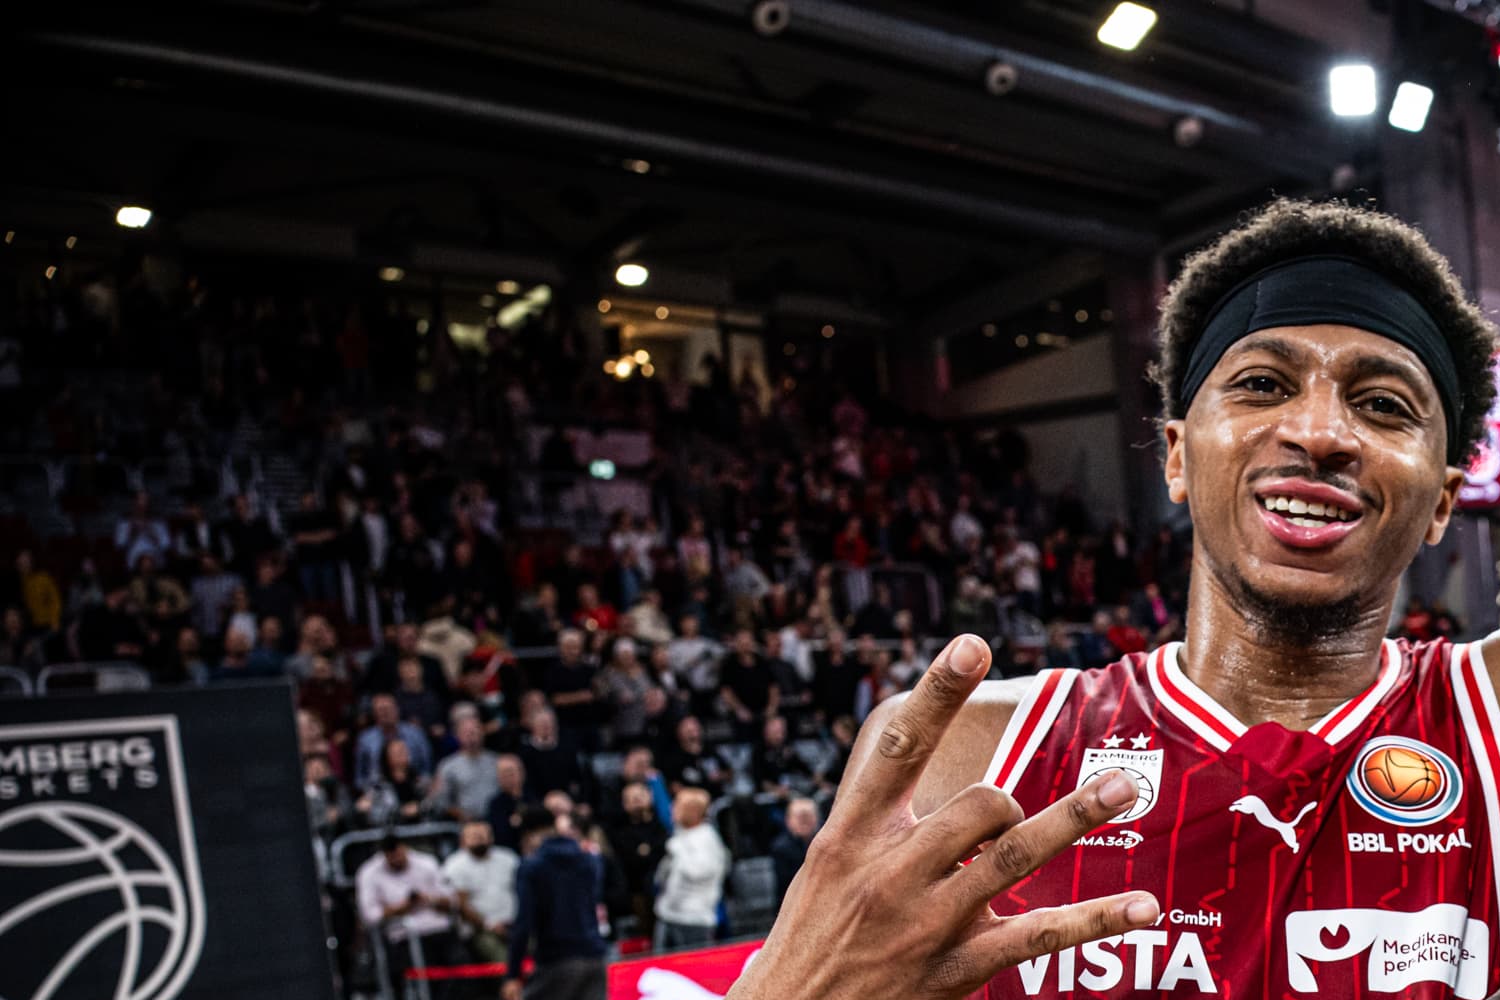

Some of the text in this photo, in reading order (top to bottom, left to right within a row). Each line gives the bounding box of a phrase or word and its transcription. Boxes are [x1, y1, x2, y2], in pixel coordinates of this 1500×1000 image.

[1347, 829, 1472, 854] BBL POKAL
[1169, 908, 1221, 927] GmbH
[1018, 930, 1218, 995] VISTA
